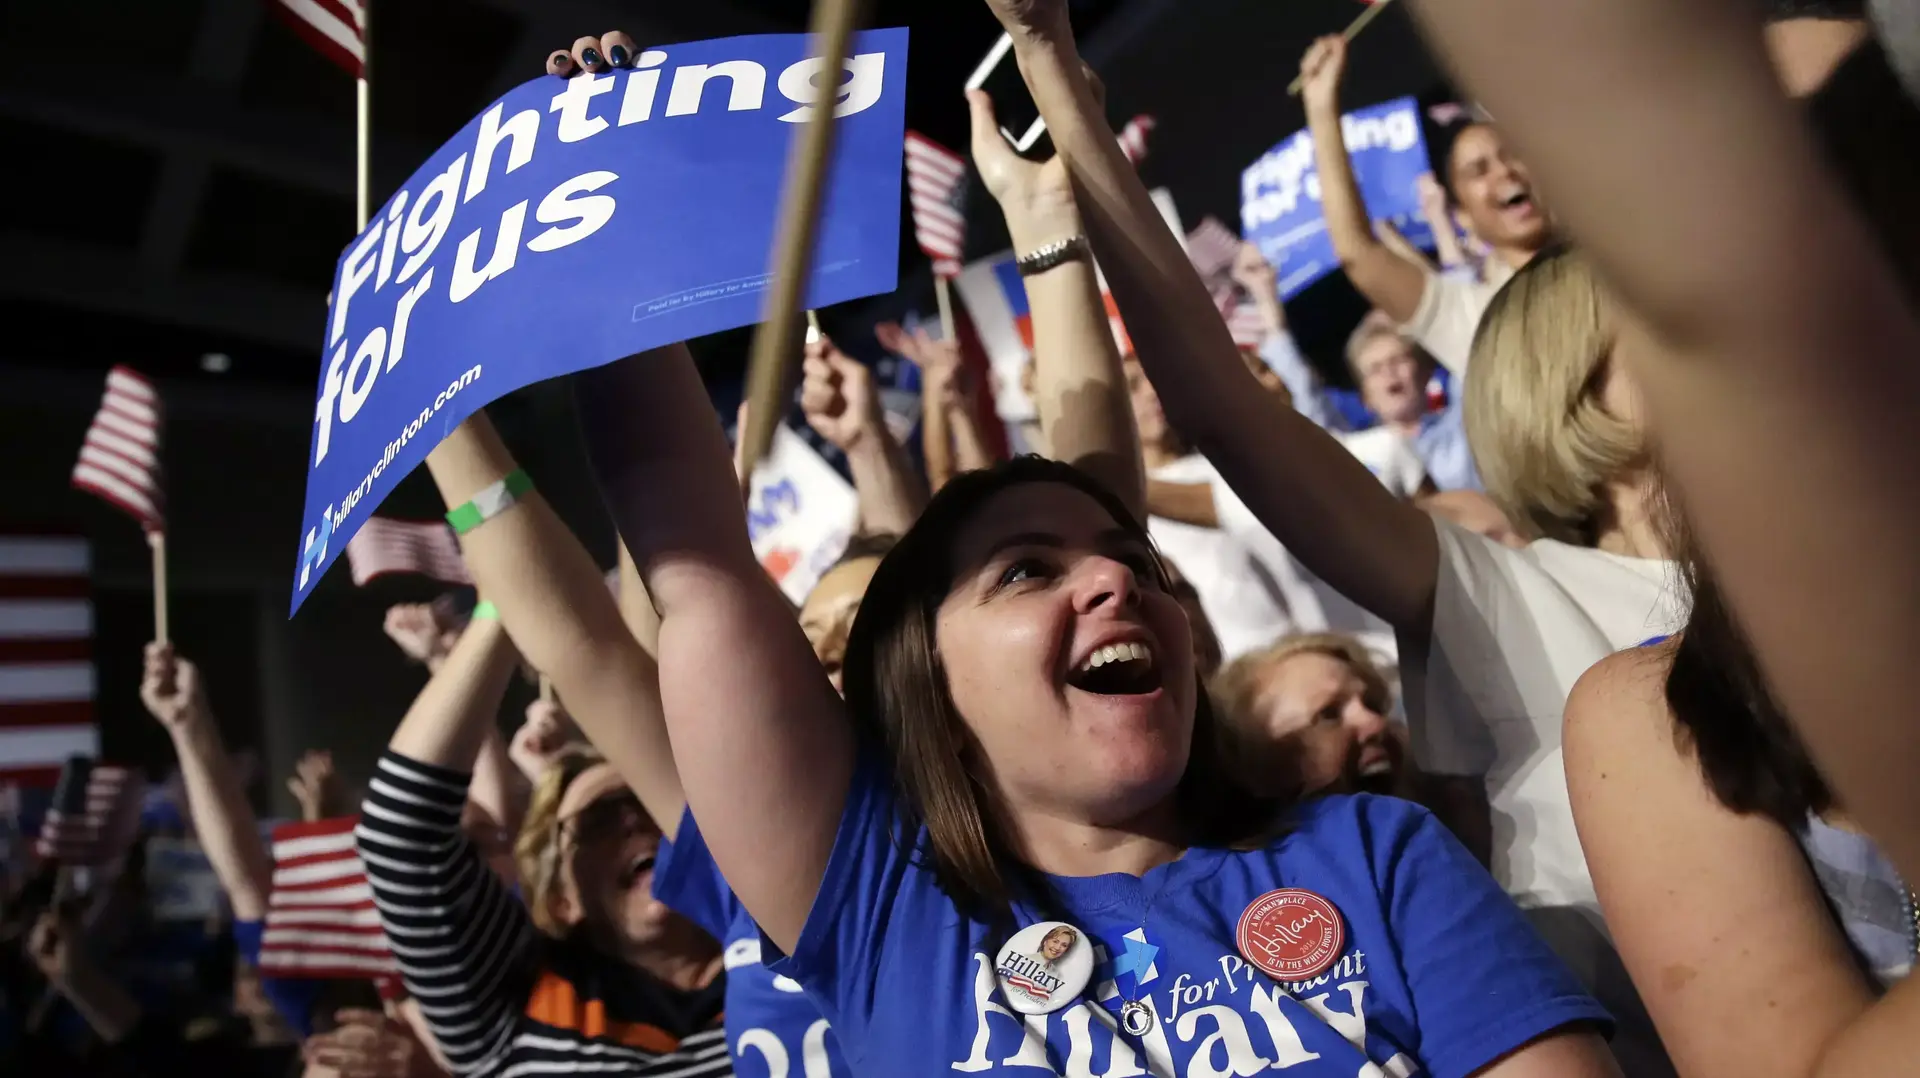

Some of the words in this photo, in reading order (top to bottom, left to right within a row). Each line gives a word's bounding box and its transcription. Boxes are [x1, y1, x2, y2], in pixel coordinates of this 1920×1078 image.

[331, 50, 886, 347] Fighting
[695, 287, 725, 299] Hillary
[726, 283, 740, 292] for
[315, 265, 434, 468] for
[450, 171, 619, 303] us
[332, 364, 482, 534] hillaryclinton.com
[1283, 896, 1307, 906] PLACE
[1251, 909, 1333, 958] Hillary
[1266, 956, 1275, 965] IS
[1275, 960, 1285, 969] IN
[1286, 961, 1303, 970] THE
[1303, 947, 1328, 966] WHITE
[1321, 926, 1333, 949] HOUSE
[1300, 939, 1316, 954] 2016
[1001, 950, 1066, 994] Hillary
[1010, 986, 1021, 994] for
[1020, 988, 1047, 1008] President
[1165, 973, 1220, 1024] for
